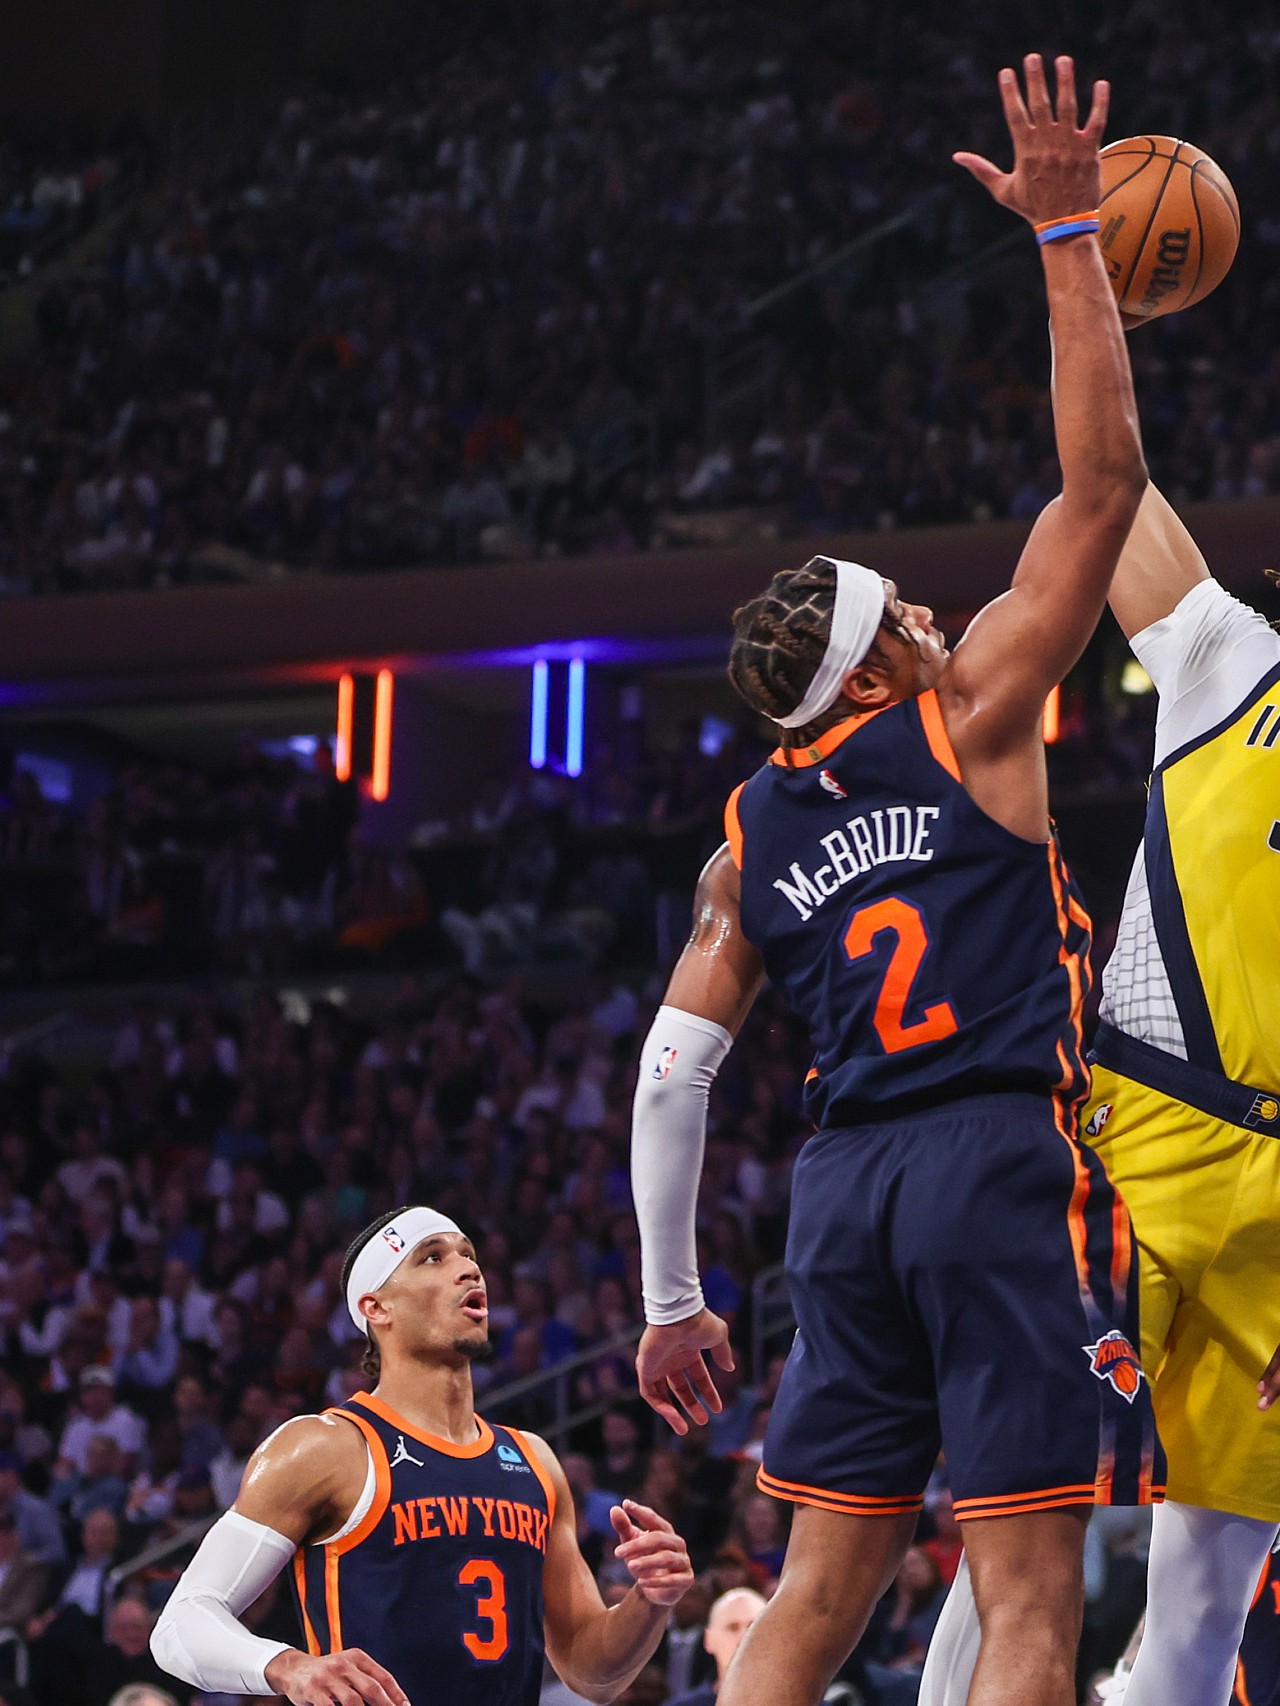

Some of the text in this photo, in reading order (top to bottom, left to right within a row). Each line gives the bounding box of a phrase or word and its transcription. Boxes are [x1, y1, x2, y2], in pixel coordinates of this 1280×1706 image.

[772, 806, 941, 922] McBRIDE
[843, 896, 959, 1055] 2
[1094, 1339, 1140, 1370] KNIC
[391, 1496, 549, 1556] NEW YORK
[458, 1558, 510, 1661] 3
